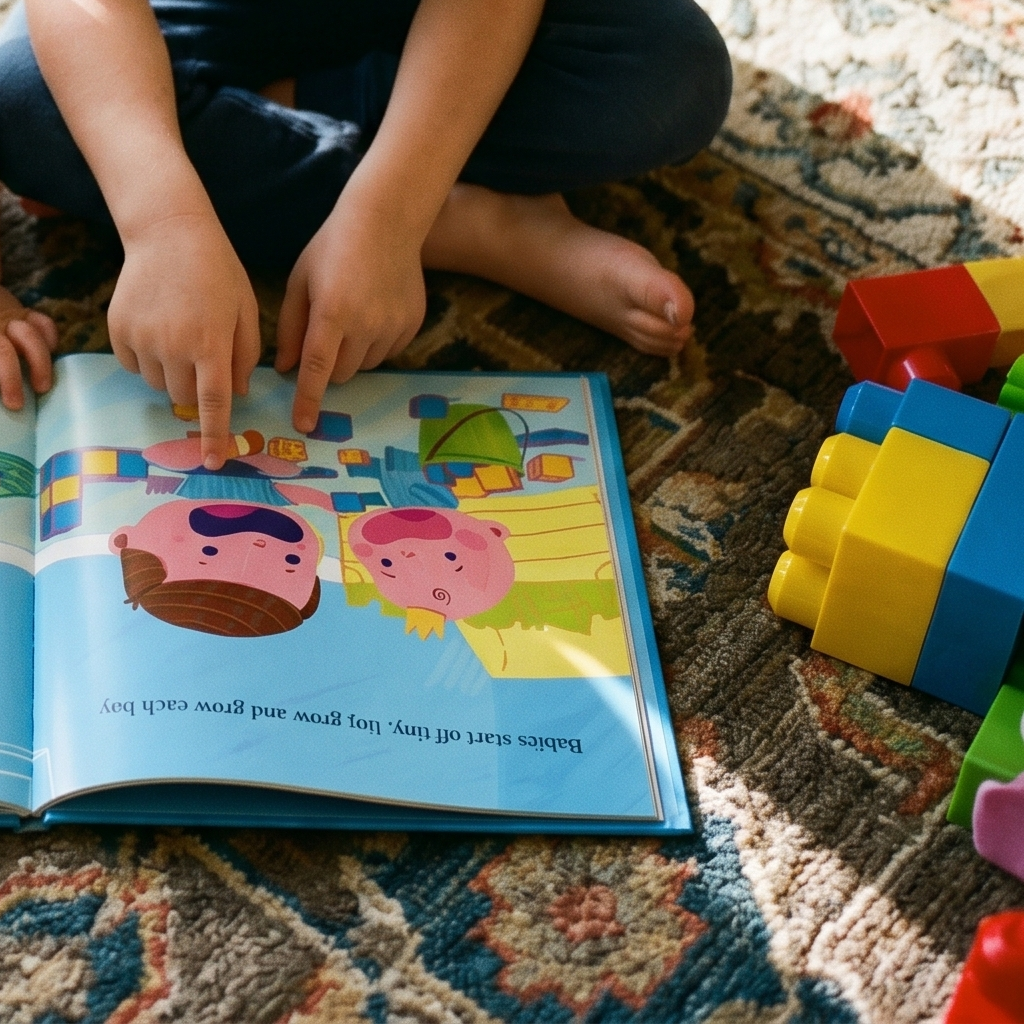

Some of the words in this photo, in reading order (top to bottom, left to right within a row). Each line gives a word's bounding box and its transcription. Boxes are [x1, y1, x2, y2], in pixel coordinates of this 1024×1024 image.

[142, 699, 189, 716] each
[194, 699, 245, 715] grow
[251, 705, 287, 720] and
[293, 710, 342, 726] grow
[435, 728, 461, 744] off
